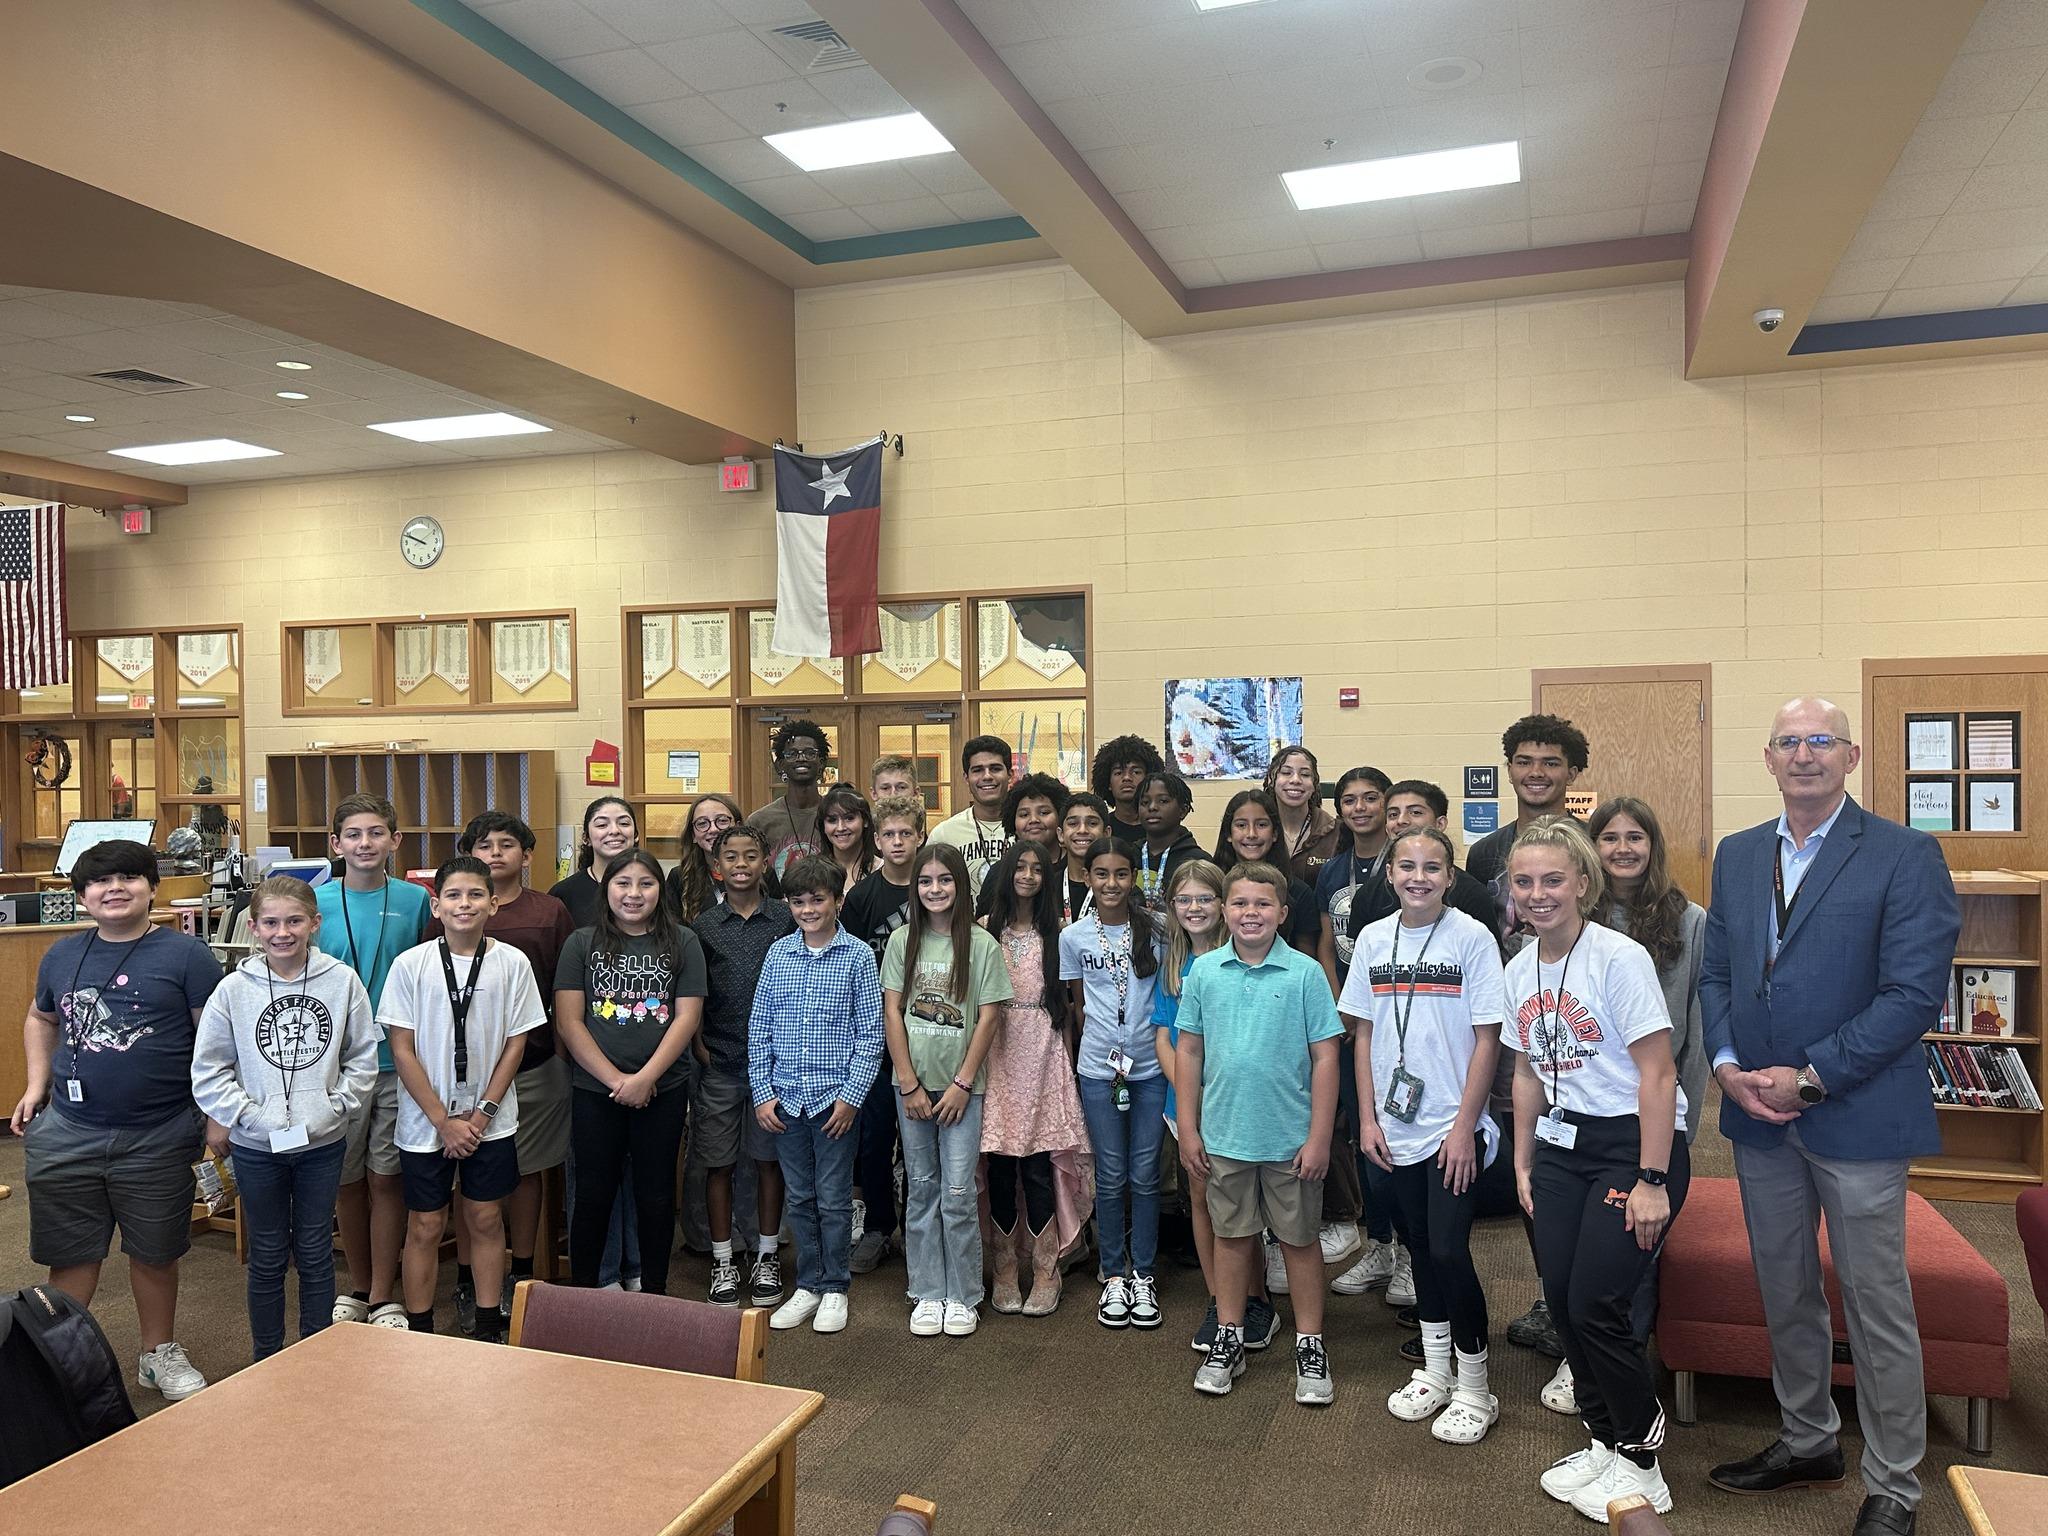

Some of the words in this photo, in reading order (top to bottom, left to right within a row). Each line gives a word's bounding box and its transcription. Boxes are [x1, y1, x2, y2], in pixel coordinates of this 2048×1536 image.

[723, 464, 748, 489] EXIT
[124, 511, 144, 533] EXIT
[121, 663, 140, 671] 2018
[899, 666, 917, 674] 2019
[1041, 662, 1060, 670] 2021
[190, 669, 207, 677] 2018
[307, 677, 322, 685] 2018
[131, 694, 148, 708] EXIT
[1914, 789, 1933, 802] stay
[590, 951, 673, 973] HELLO
[592, 970, 673, 993] KITTY
[1966, 991, 2008, 1002] Educated
[259, 999, 289, 1046] BOMBERS
[293, 997, 329, 1040] FASTPITCH
[909, 1025, 962, 1038] PERFORMANCE
[271, 1048, 295, 1058] BATTLE
[296, 1046, 321, 1056] TESTED
